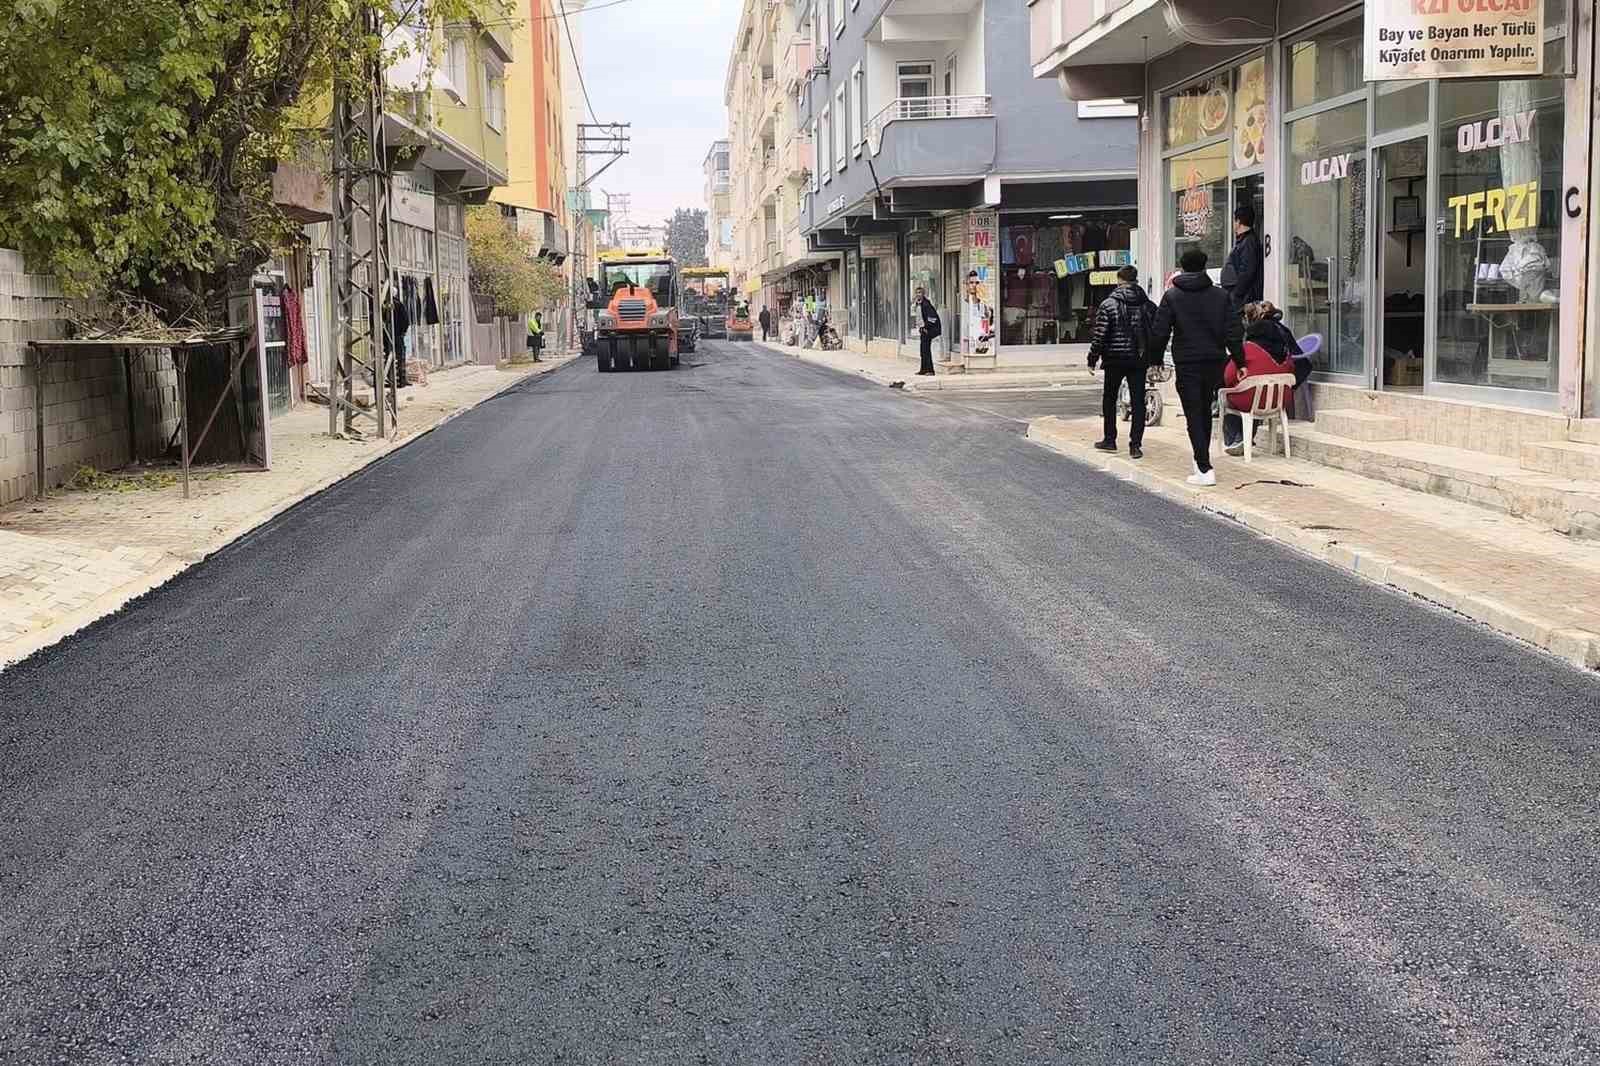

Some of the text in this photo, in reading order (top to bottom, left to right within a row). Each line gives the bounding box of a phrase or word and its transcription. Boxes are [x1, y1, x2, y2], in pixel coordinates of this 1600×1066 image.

[1379, 22, 1535, 44] Bay ve Bayan Her Türlü
[1430, 47, 1485, 61] Onarımı
[1457, 109, 1537, 153] OLCAY
[1301, 153, 1352, 185] OLCAY
[1565, 186, 1582, 218] C
